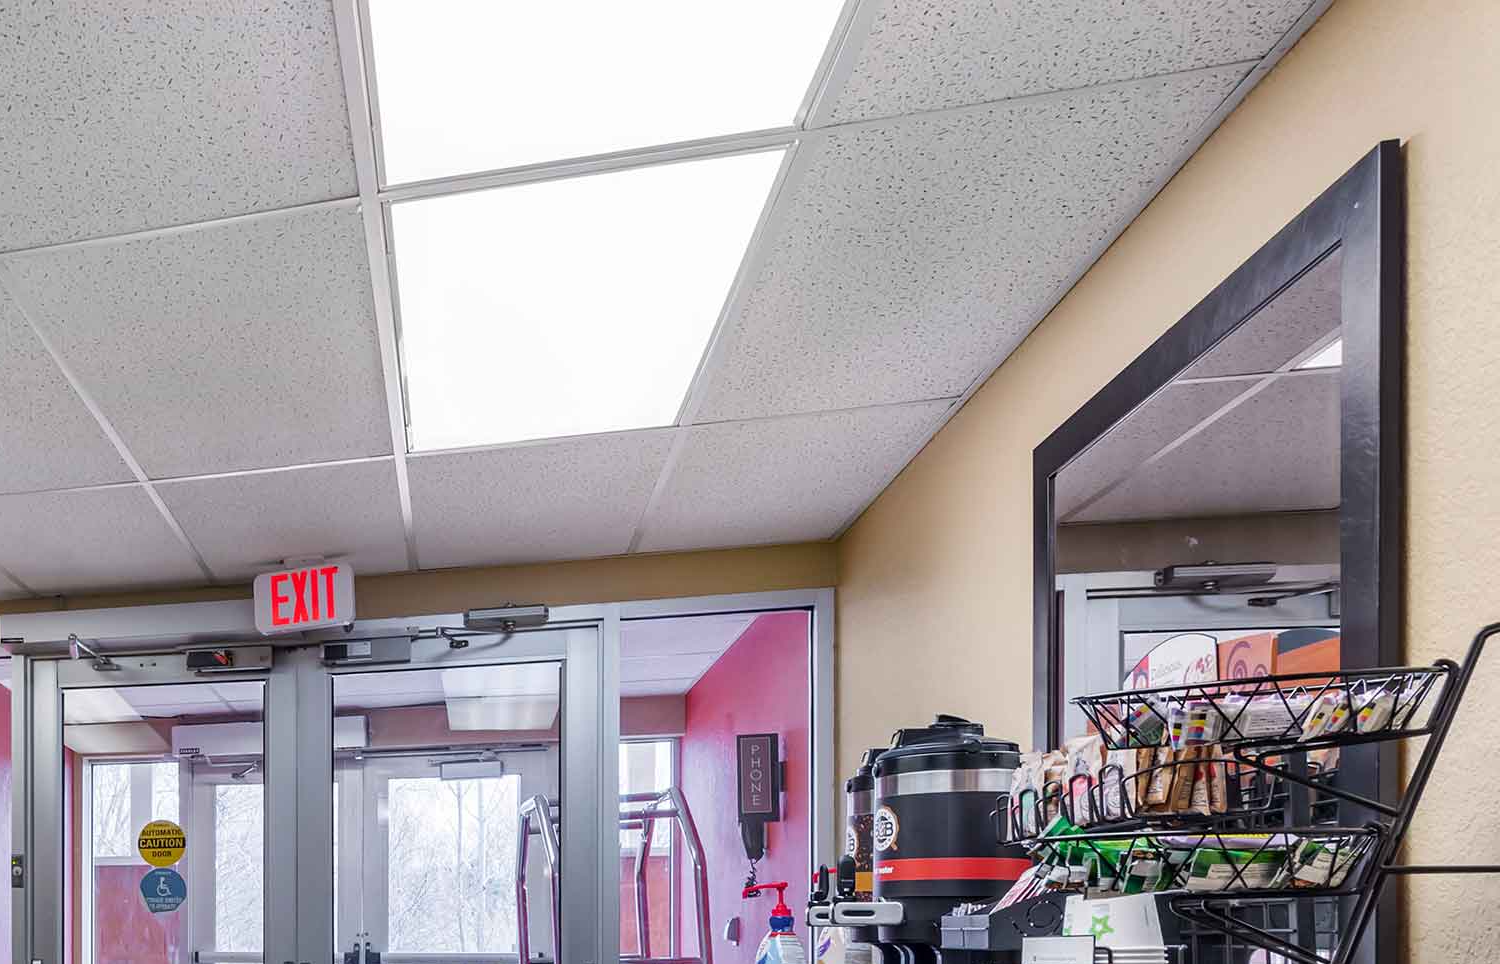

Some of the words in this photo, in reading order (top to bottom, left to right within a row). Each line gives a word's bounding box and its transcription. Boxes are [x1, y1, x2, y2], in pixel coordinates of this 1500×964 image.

[271, 566, 339, 626] EXIT
[750, 744, 762, 806] PHONE
[140, 839, 183, 848] CAUTION
[141, 829, 183, 837] AUTOMATIC
